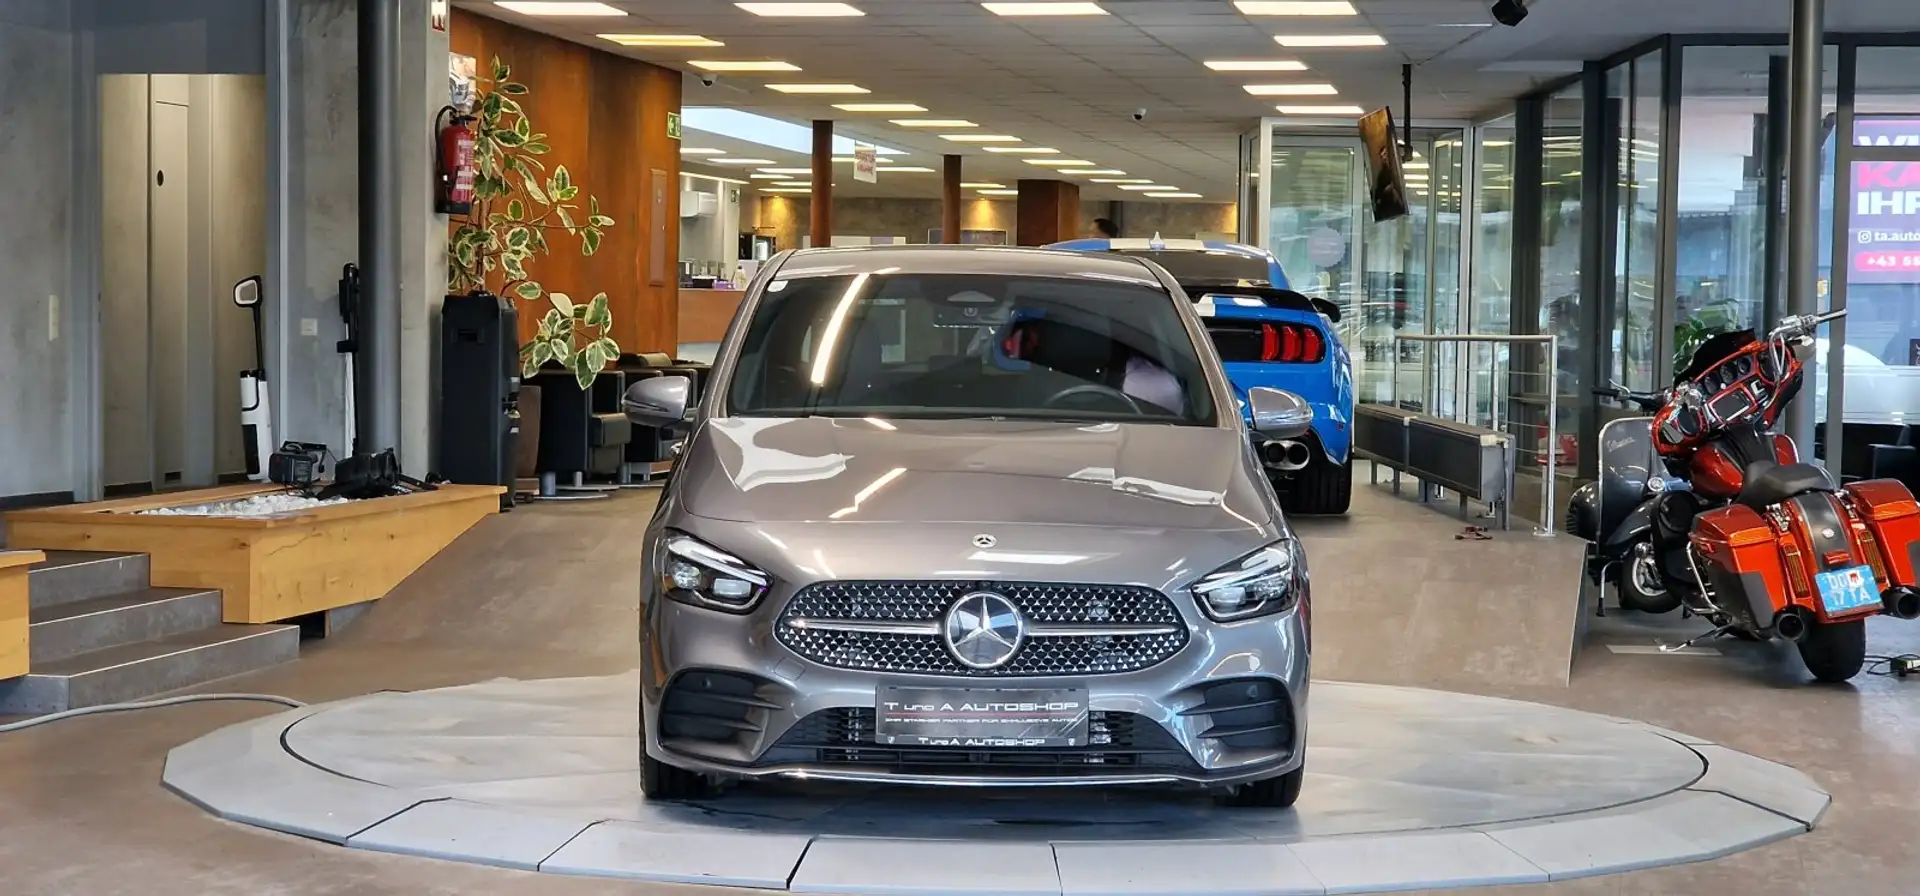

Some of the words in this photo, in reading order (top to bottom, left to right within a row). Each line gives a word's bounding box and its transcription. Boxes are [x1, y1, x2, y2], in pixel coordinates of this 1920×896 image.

[884, 702, 899, 710] T
[940, 703, 954, 711] A
[960, 702, 1079, 711] AUTOSHOP
[965, 738, 1046, 746] AUTOSHOP
